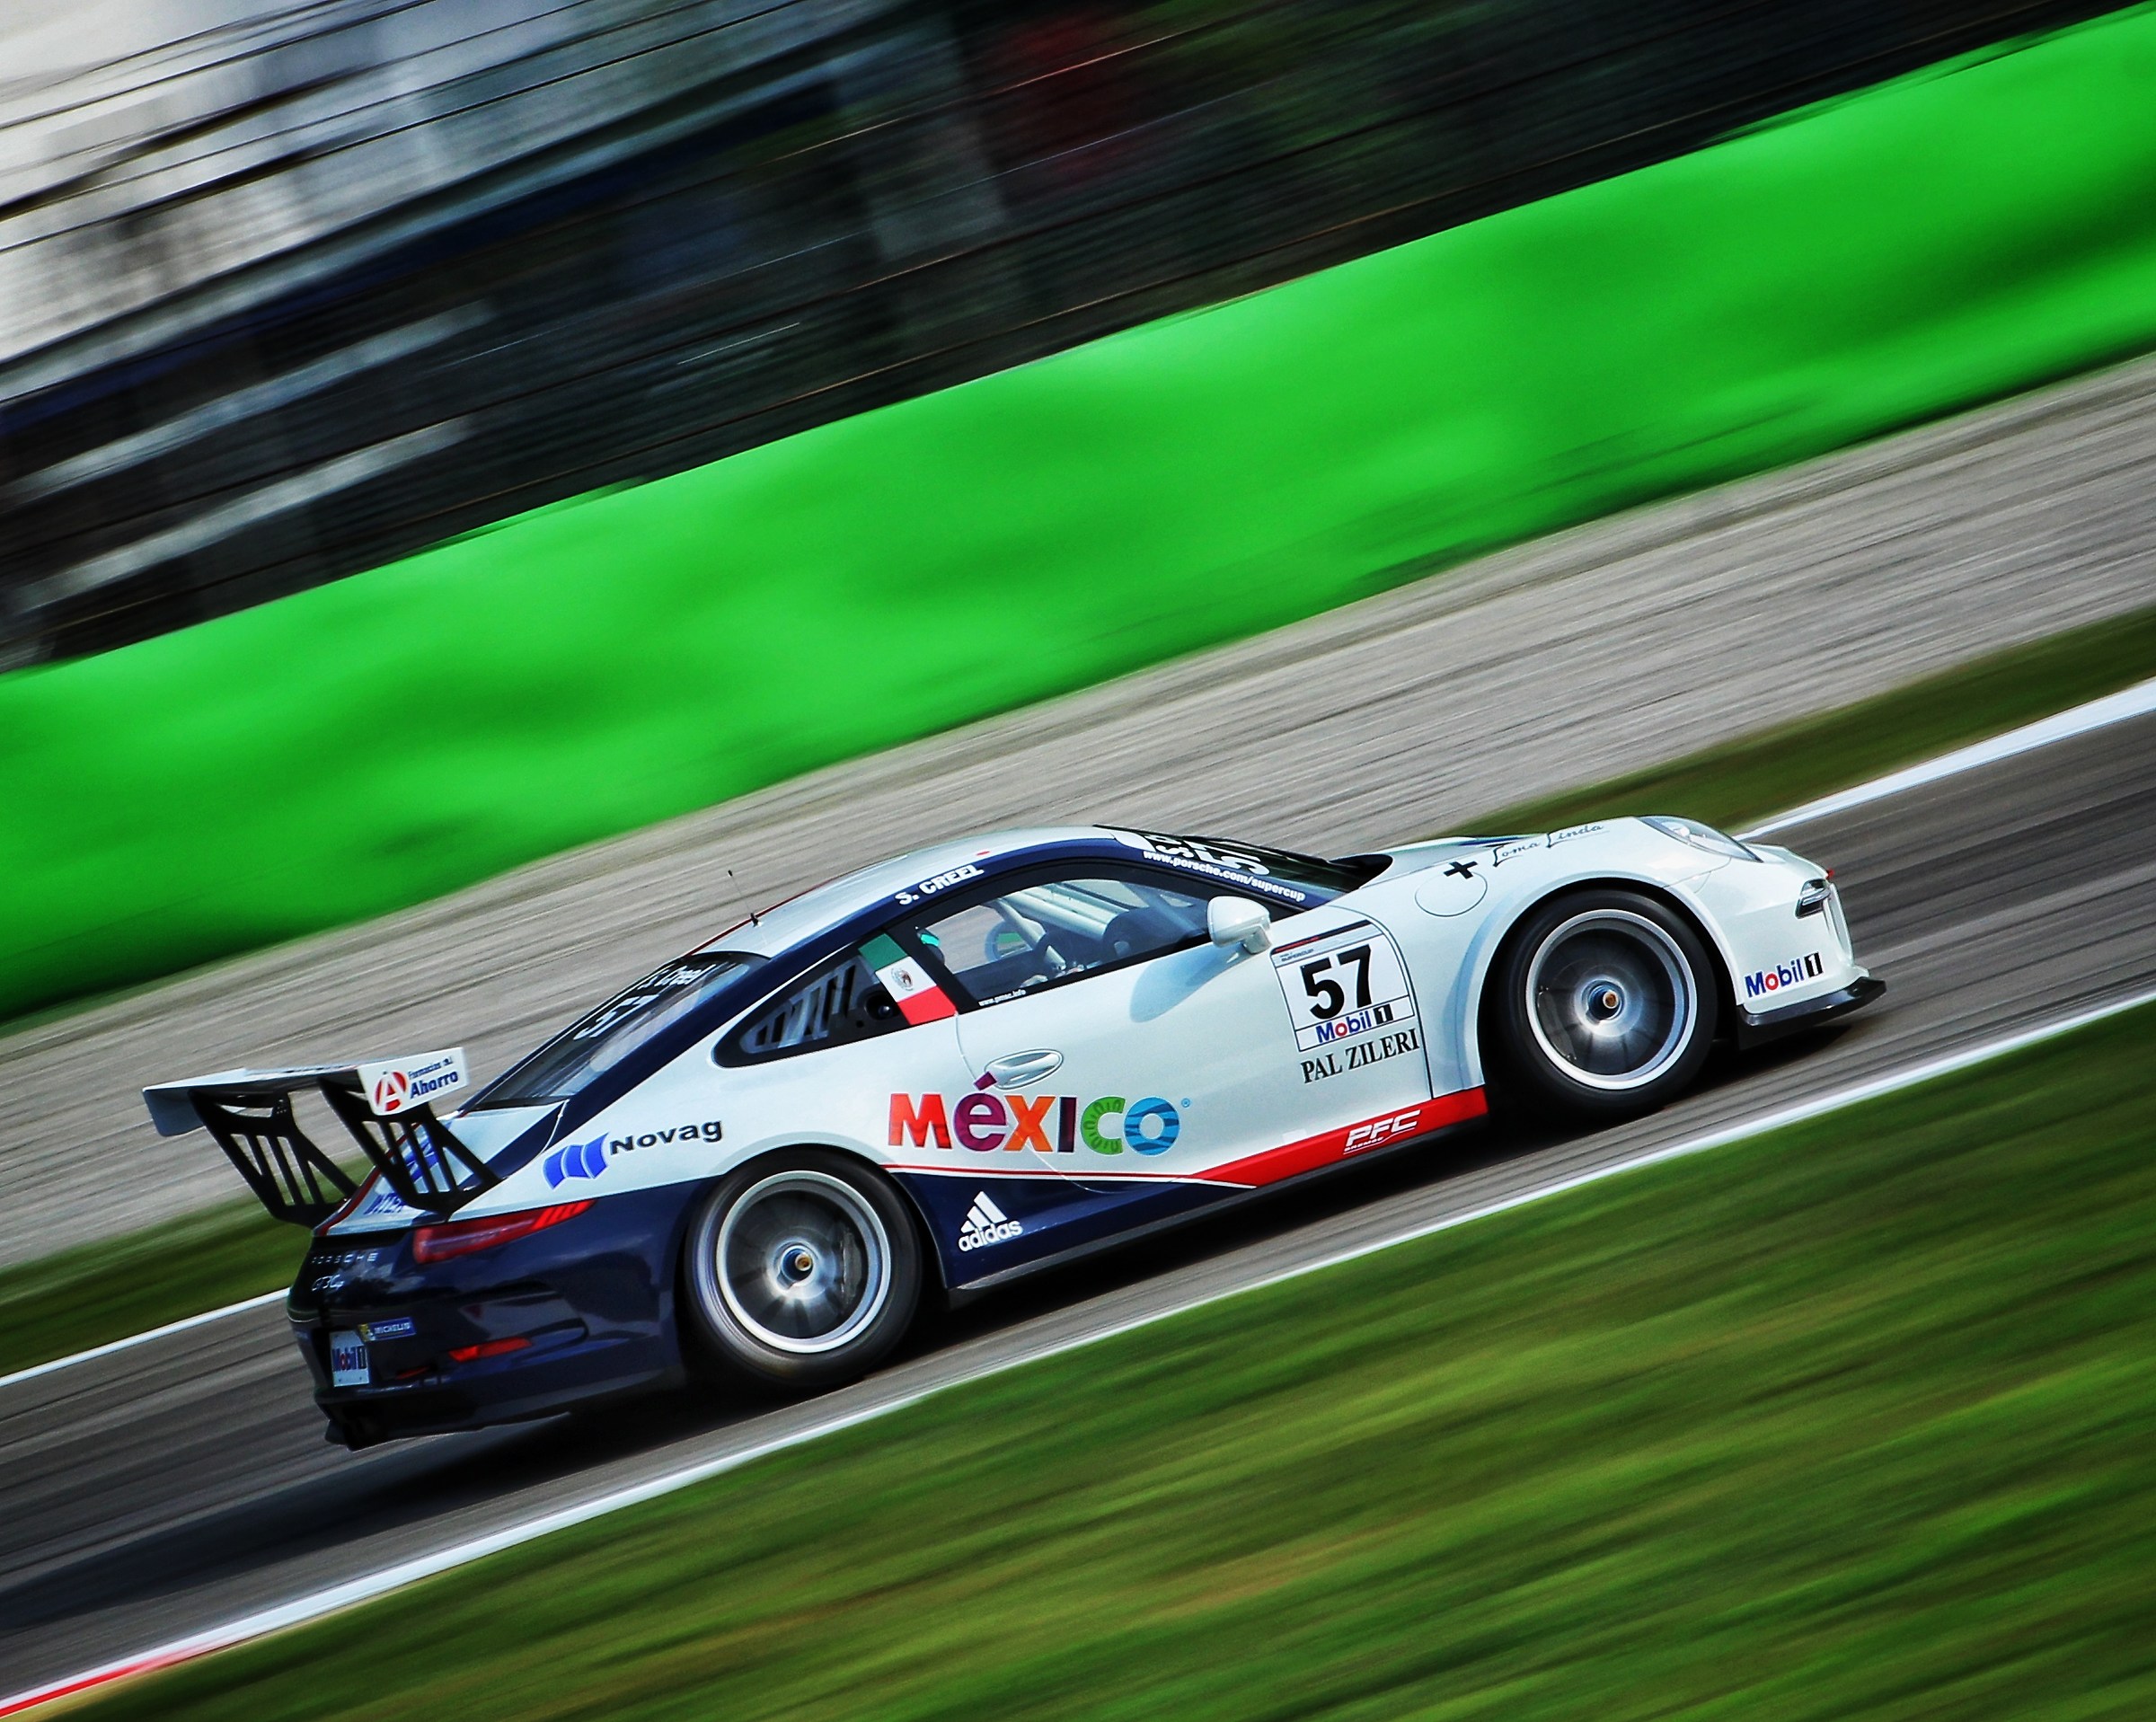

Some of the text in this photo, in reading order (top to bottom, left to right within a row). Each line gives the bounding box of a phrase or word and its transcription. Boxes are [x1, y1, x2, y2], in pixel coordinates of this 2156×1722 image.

[1546, 824, 1606, 849] Linda
[894, 864, 985, 905] S. CREEL
[1143, 850, 1306, 902] www.porsche.com/supercup
[1300, 944, 1373, 1020] 57
[1745, 952, 1821, 998] Mobil 1
[1315, 1010, 1373, 1044] Mobil
[1300, 1028, 1421, 1085] PAL ZILERI
[410, 1070, 460, 1099] Ahorro
[609, 1120, 723, 1157] Novag
[1345, 1108, 1422, 1147] PFC
[957, 1218, 1024, 1253] adidas
